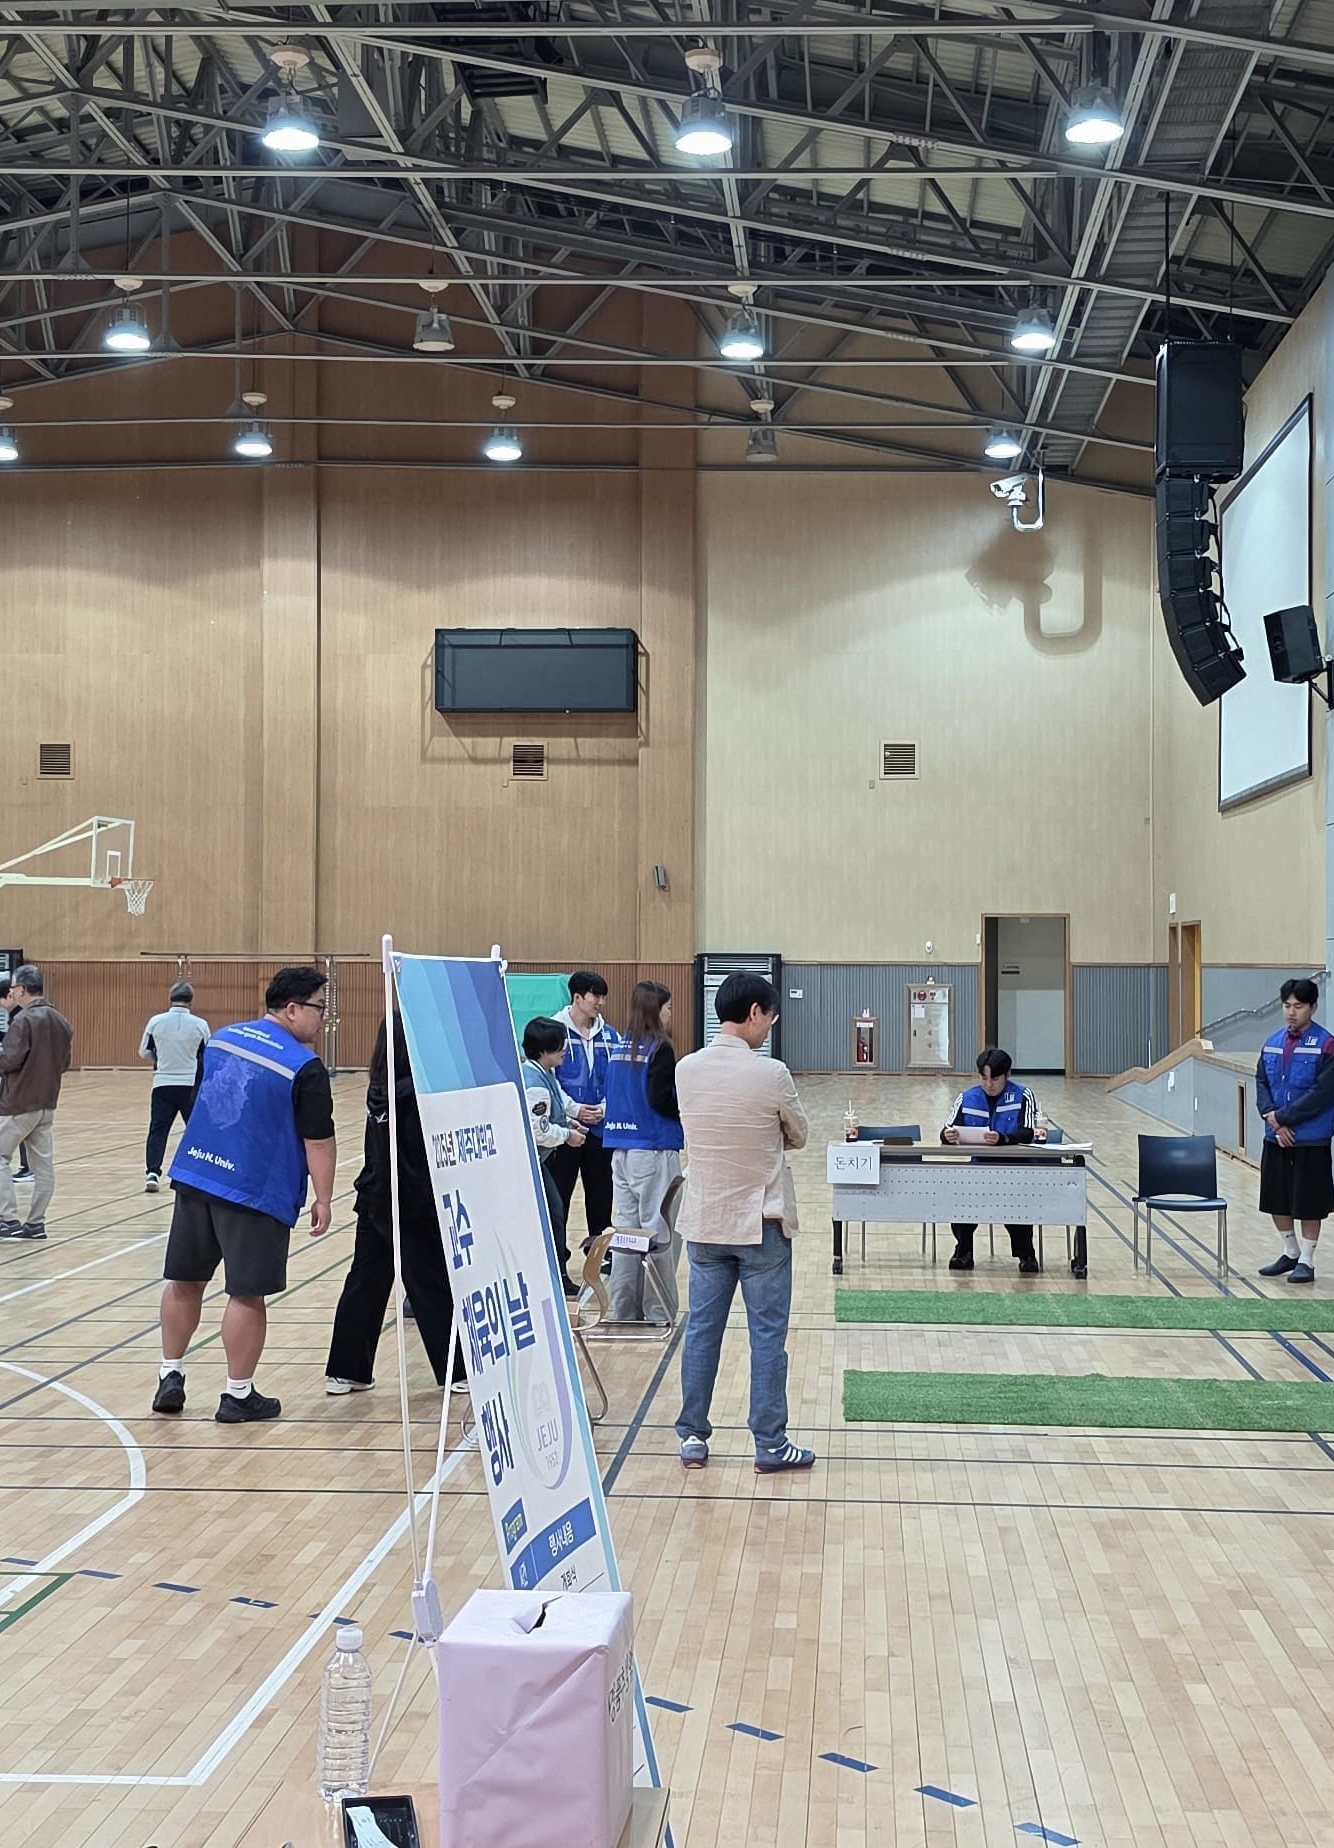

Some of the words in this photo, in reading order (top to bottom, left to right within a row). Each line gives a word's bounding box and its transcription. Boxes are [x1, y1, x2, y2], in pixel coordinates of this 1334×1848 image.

[187, 1146, 206, 1161] Jeju
[205, 1152, 214, 1164] N.
[214, 1156, 236, 1172] Univ.
[455, 1123, 497, 1163] 제주대학교
[834, 1156, 872, 1171] 돈치기
[442, 1189, 474, 1270] 교수
[461, 1280, 511, 1376] 체육의
[503, 1271, 536, 1351] 날
[480, 1391, 515, 1487] 행사
[537, 1419, 559, 1451] JEJU
[548, 1520, 575, 1558] 행사내용
